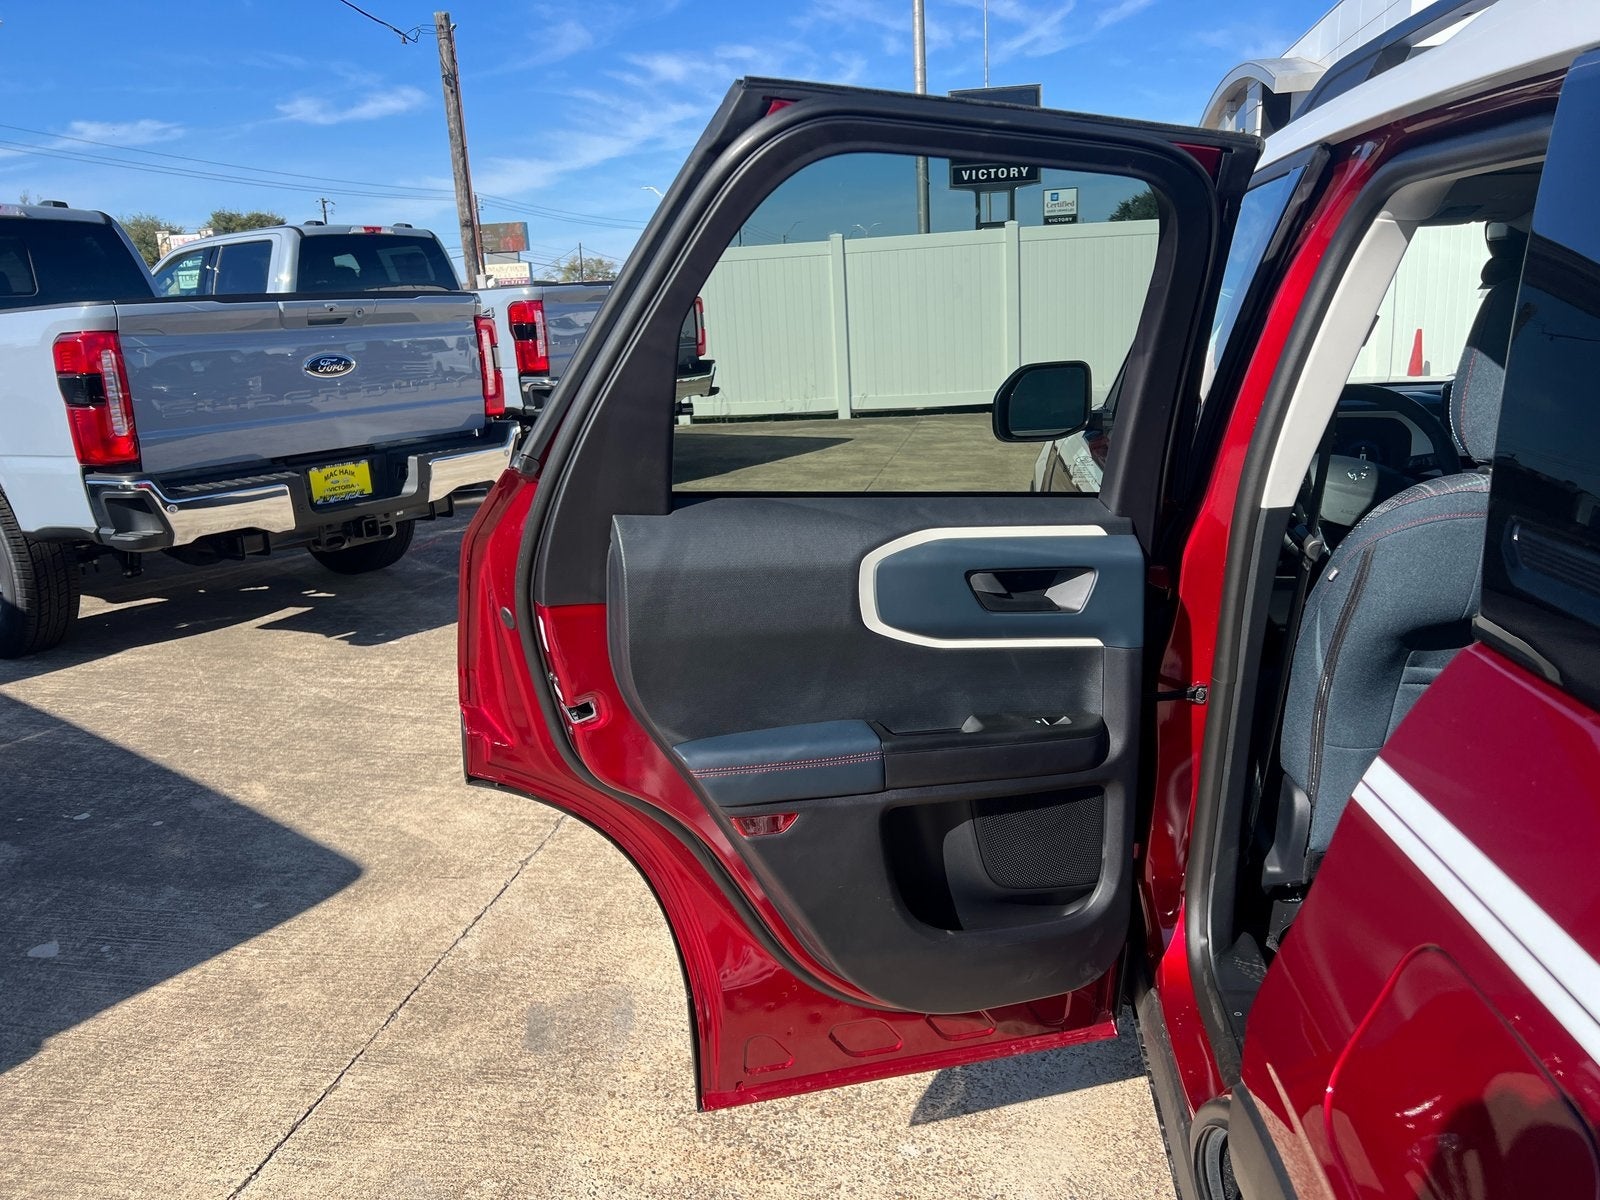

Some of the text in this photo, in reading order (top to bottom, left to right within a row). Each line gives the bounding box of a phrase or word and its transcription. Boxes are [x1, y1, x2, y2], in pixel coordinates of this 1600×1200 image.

[961, 166, 1029, 180] VICTORY
[1046, 200, 1075, 208] Certified
[317, 358, 345, 373] Ford
[323, 469, 338, 481] MAC
[328, 483, 355, 492] VICTORIA
